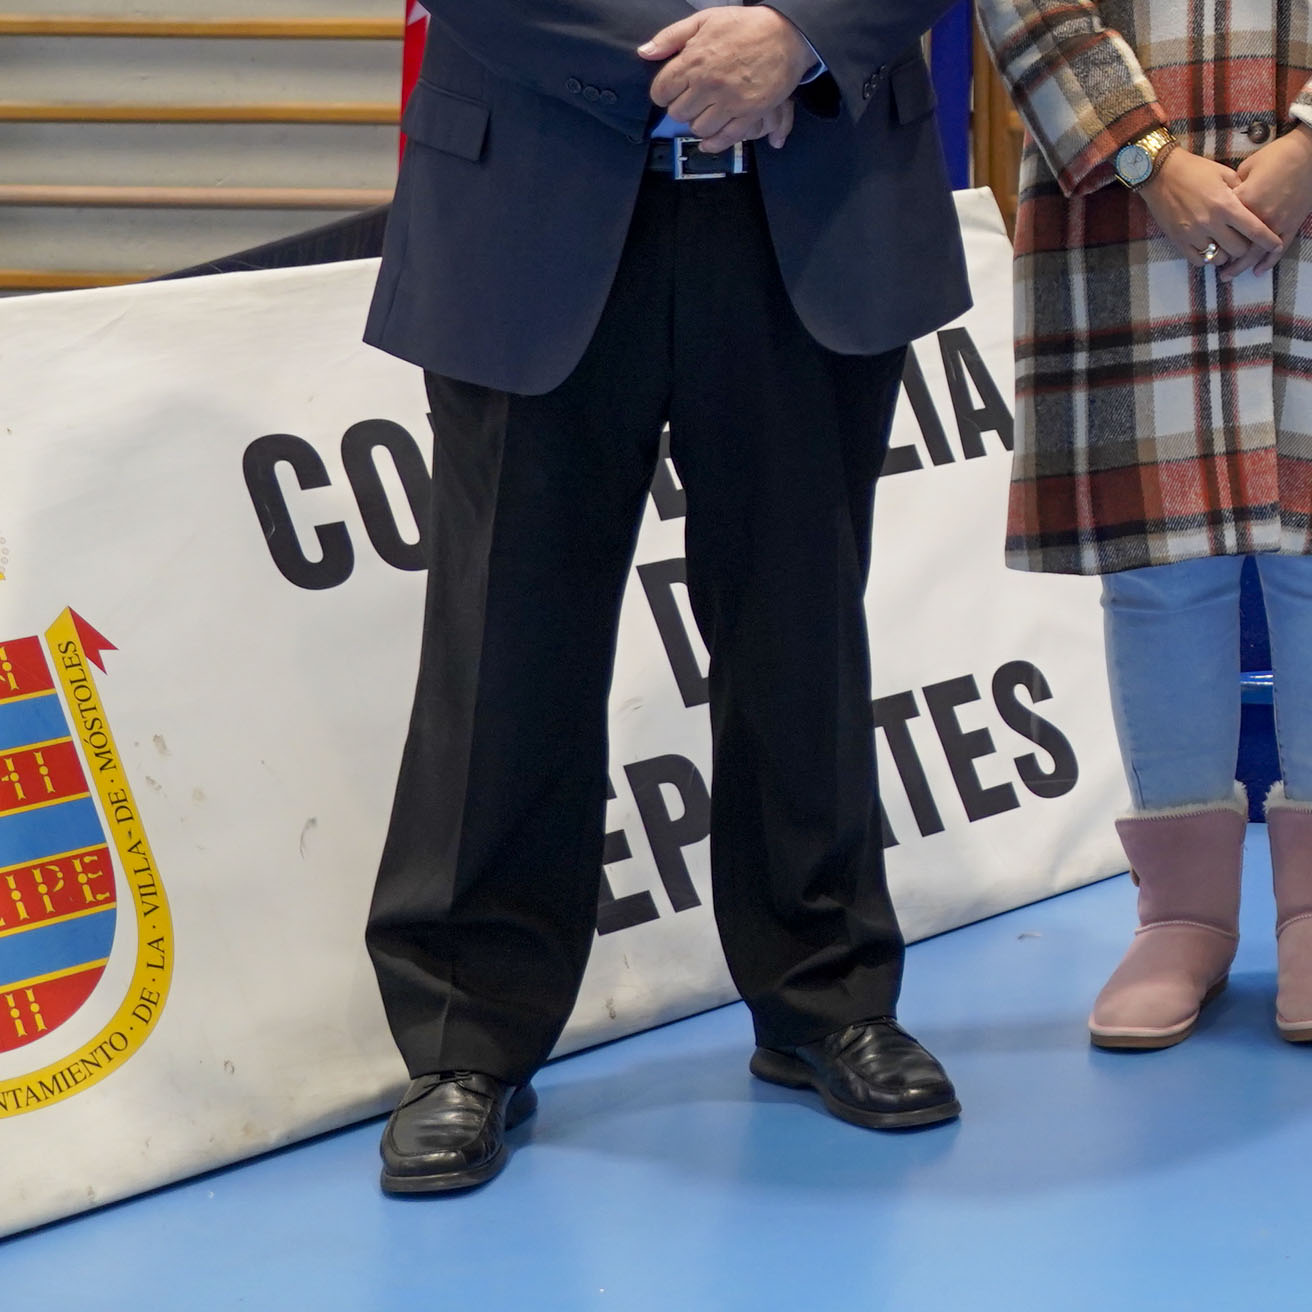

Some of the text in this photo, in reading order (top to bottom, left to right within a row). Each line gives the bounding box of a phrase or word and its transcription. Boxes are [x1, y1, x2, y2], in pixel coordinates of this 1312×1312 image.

[57, 640, 117, 771] MÓSTOLES
[107, 788, 134, 824] DE
[128, 840, 160, 918] VILLA
[146, 936, 166, 971] LA
[132, 987, 161, 1025] DE
